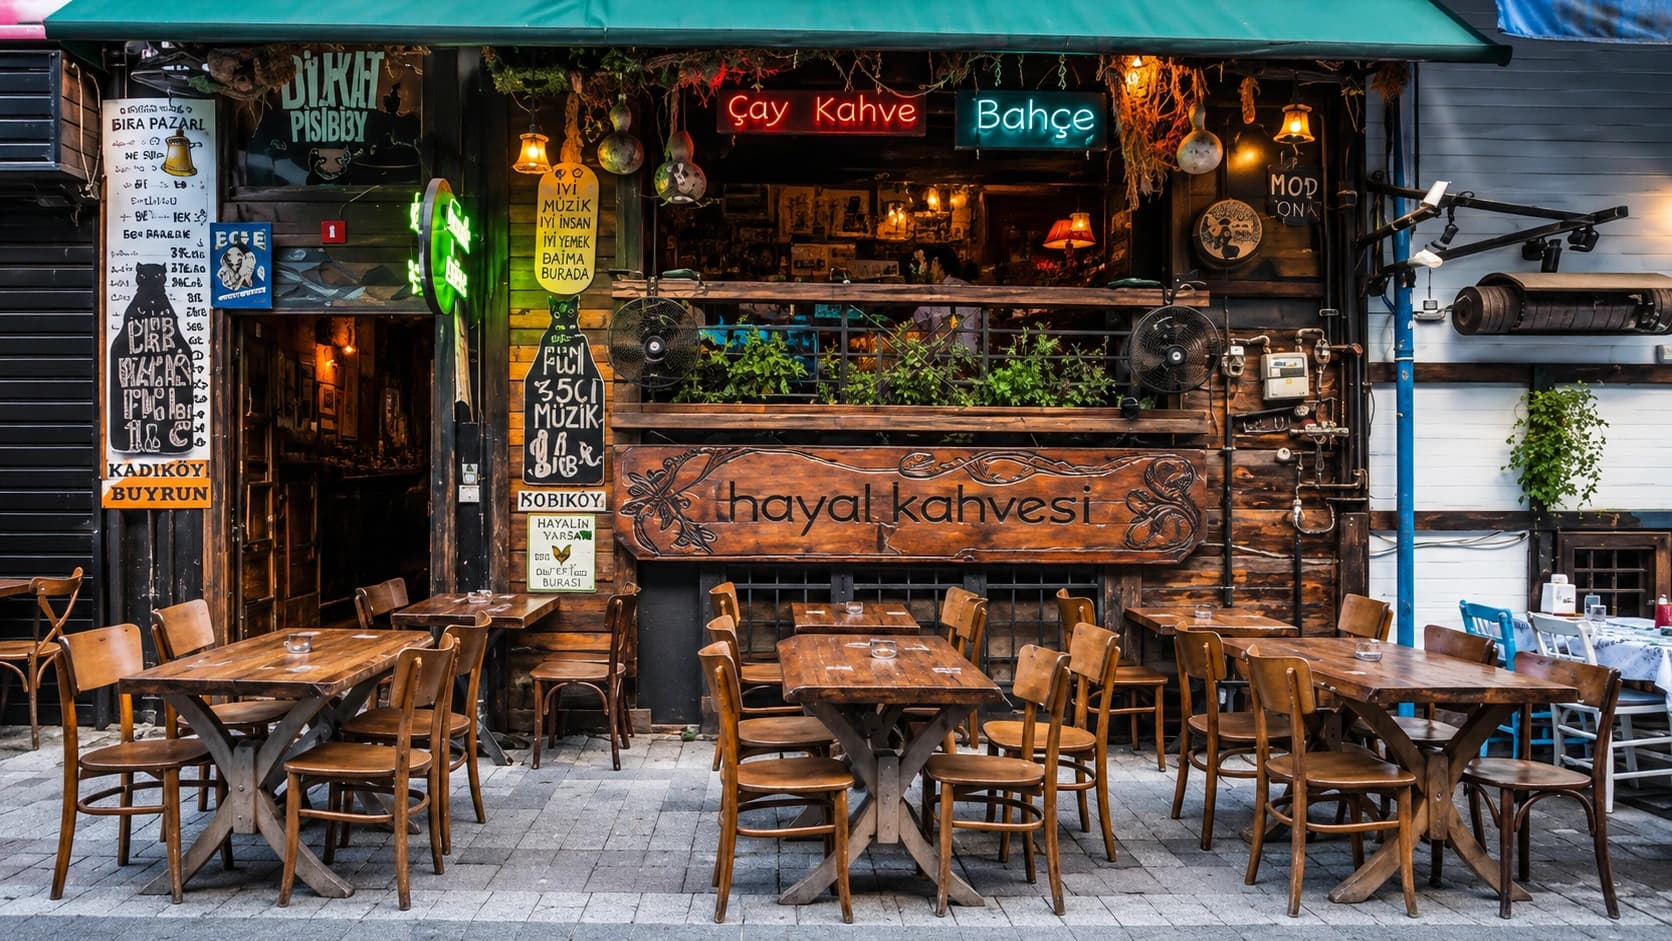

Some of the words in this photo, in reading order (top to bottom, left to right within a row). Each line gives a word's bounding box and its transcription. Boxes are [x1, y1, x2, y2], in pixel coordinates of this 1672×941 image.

[728, 95, 789, 127] Çay
[815, 94, 917, 123] Kahve
[977, 98, 1095, 139] Bahçe
[541, 267, 590, 281] BURADA
[534, 402, 600, 429] MÜZİK
[108, 460, 204, 478] KADIKÖY
[111, 486, 209, 501] BUYRUN
[729, 481, 873, 536] hayal
[893, 481, 1092, 524] kahvesi
